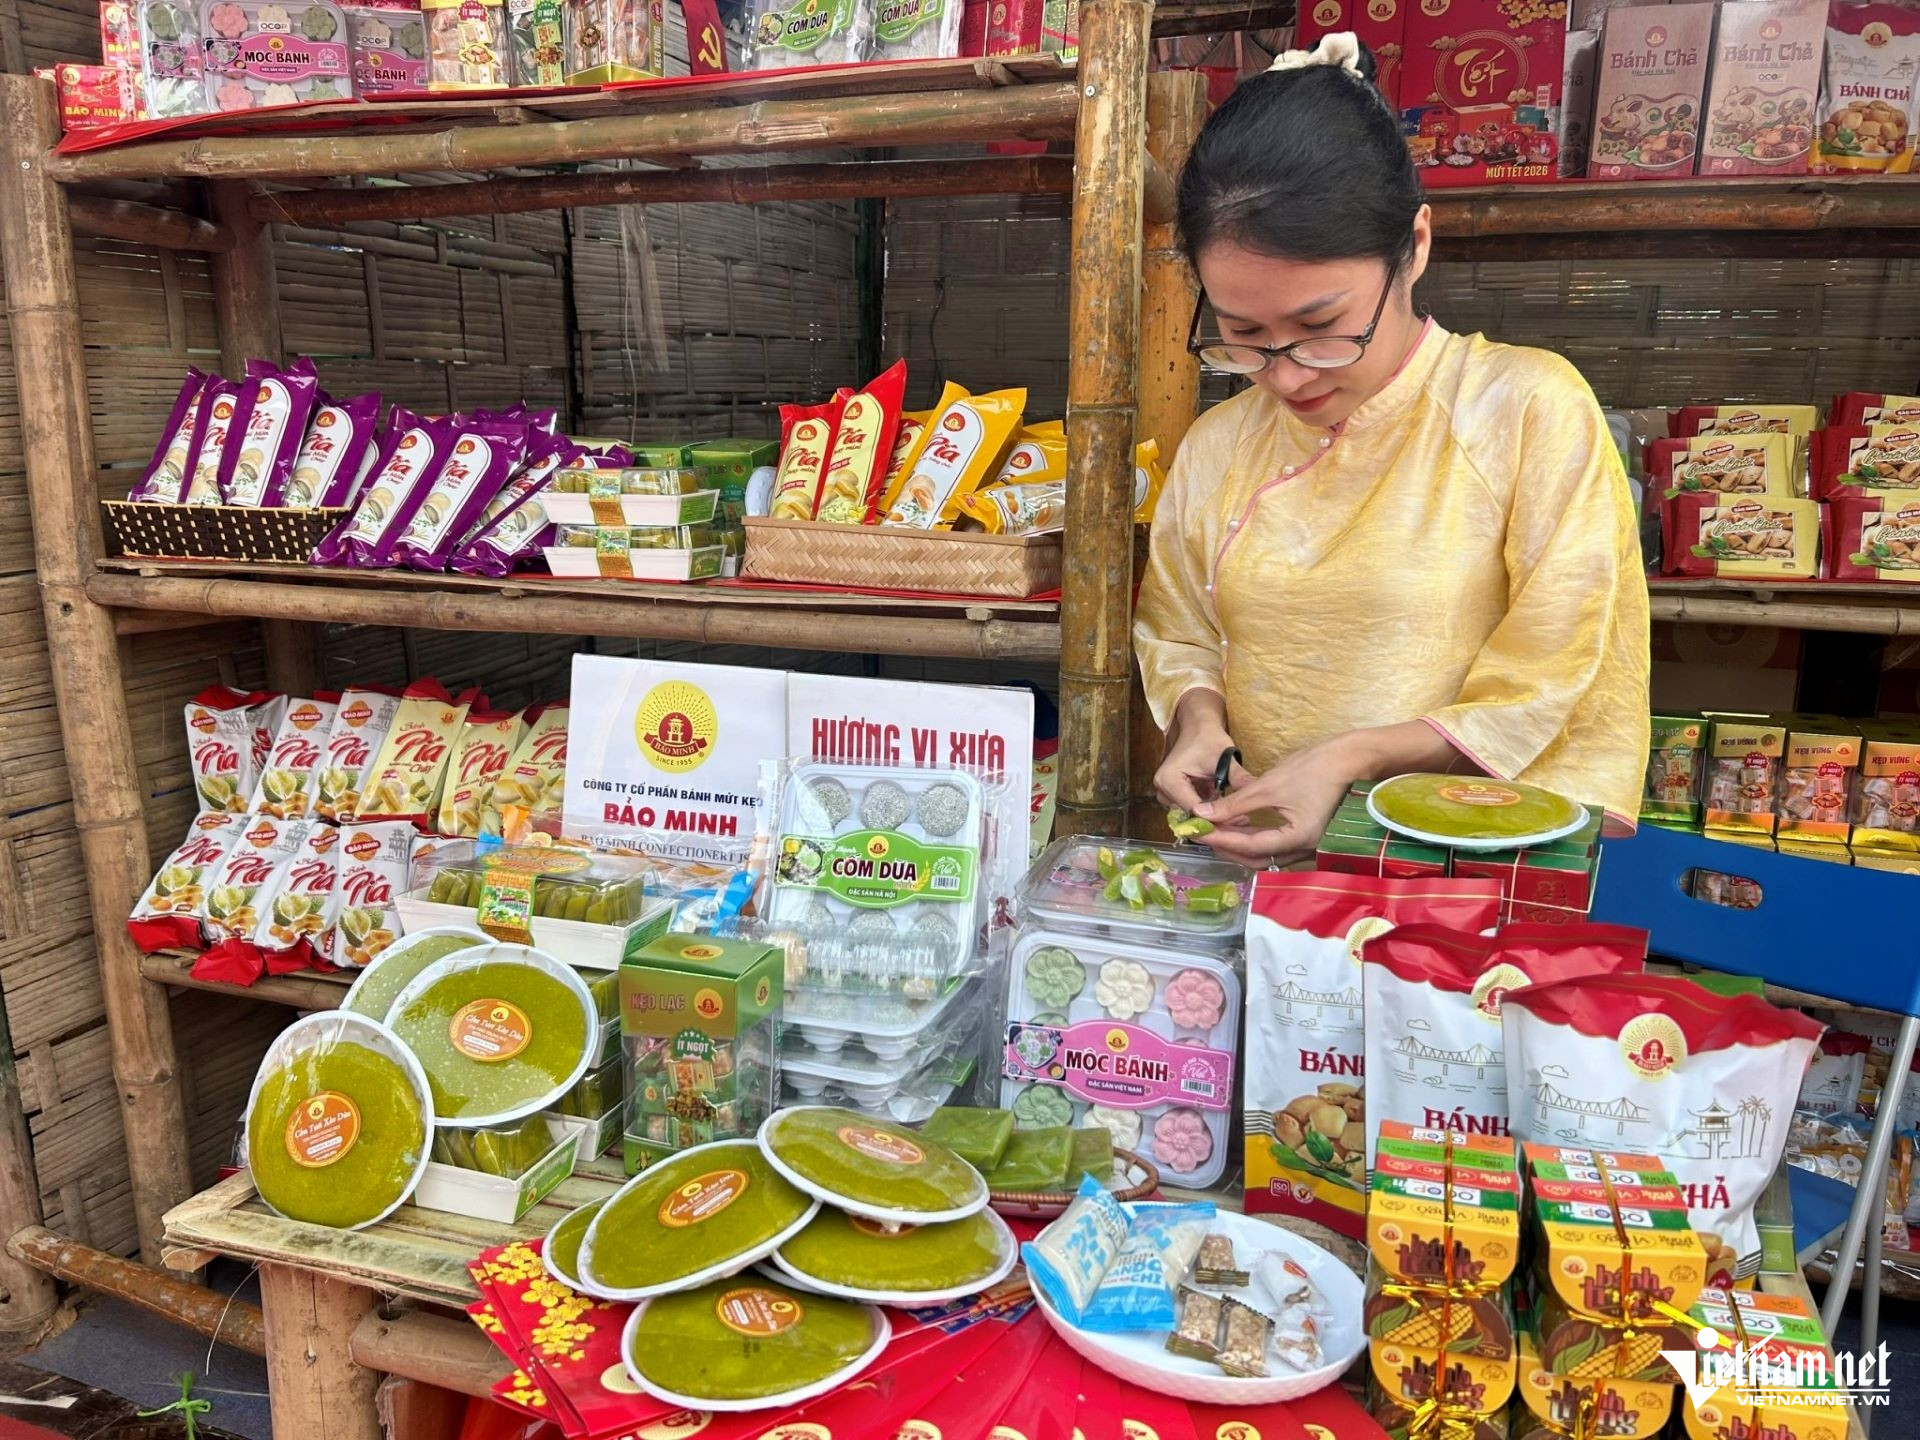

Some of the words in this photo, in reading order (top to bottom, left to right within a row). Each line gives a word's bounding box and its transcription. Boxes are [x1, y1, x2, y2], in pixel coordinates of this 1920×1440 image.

[1610, 51, 1657, 69] Bánh
[1664, 48, 1698, 67] Chả
[1723, 43, 1771, 62] Bánh
[1839, 83, 1878, 98] BÁNH
[1884, 84, 1911, 101] CHẢ
[1523, 165, 1548, 177] 2026
[274, 739, 322, 767] Pía
[328, 736, 371, 767] Pía
[394, 730, 447, 762] Pía
[672, 745, 696, 756] MINH
[812, 715, 900, 767] HƯƠNG
[195, 742, 239, 775] Pía
[459, 744, 510, 783] Pía
[656, 755, 675, 766] SINCE
[676, 758, 693, 766] 1955
[583, 777, 611, 792] CÔNG
[615, 782, 627, 793] TY
[630, 780, 645, 796] CỔ
[648, 783, 678, 799] PHẦN
[681, 787, 711, 803] BÁNH
[714, 790, 739, 805] MỨT
[603, 797, 656, 829] BẢO
[663, 809, 738, 837] MINH
[225, 856, 275, 885] Pía
[289, 862, 338, 892] Pía
[832, 853, 874, 878] CỐM
[343, 871, 392, 907] Pía
[848, 887, 861, 895] ĐẶC
[862, 887, 874, 896] SẢN
[875, 888, 884, 897] HÀ
[631, 991, 656, 1014] KẸO
[659, 993, 685, 1014] LẠC
[677, 1037, 686, 1051] ÍT
[686, 1039, 710, 1053] NGỌT
[1877, 1037, 1896, 1048] CH
[1064, 1047, 1109, 1074] MỘC
[1114, 1051, 1169, 1082] BÁNH
[1299, 1047, 1365, 1077] BÁN
[1088, 1080, 1101, 1088] ĐẶC
[1115, 1082, 1127, 1091] VIỆT
[1128, 1085, 1143, 1093] NAM
[1422, 1106, 1511, 1138] BÁNH
[1273, 1182, 1288, 1192] ISO
[1130, 1273, 1163, 1285] CHI
